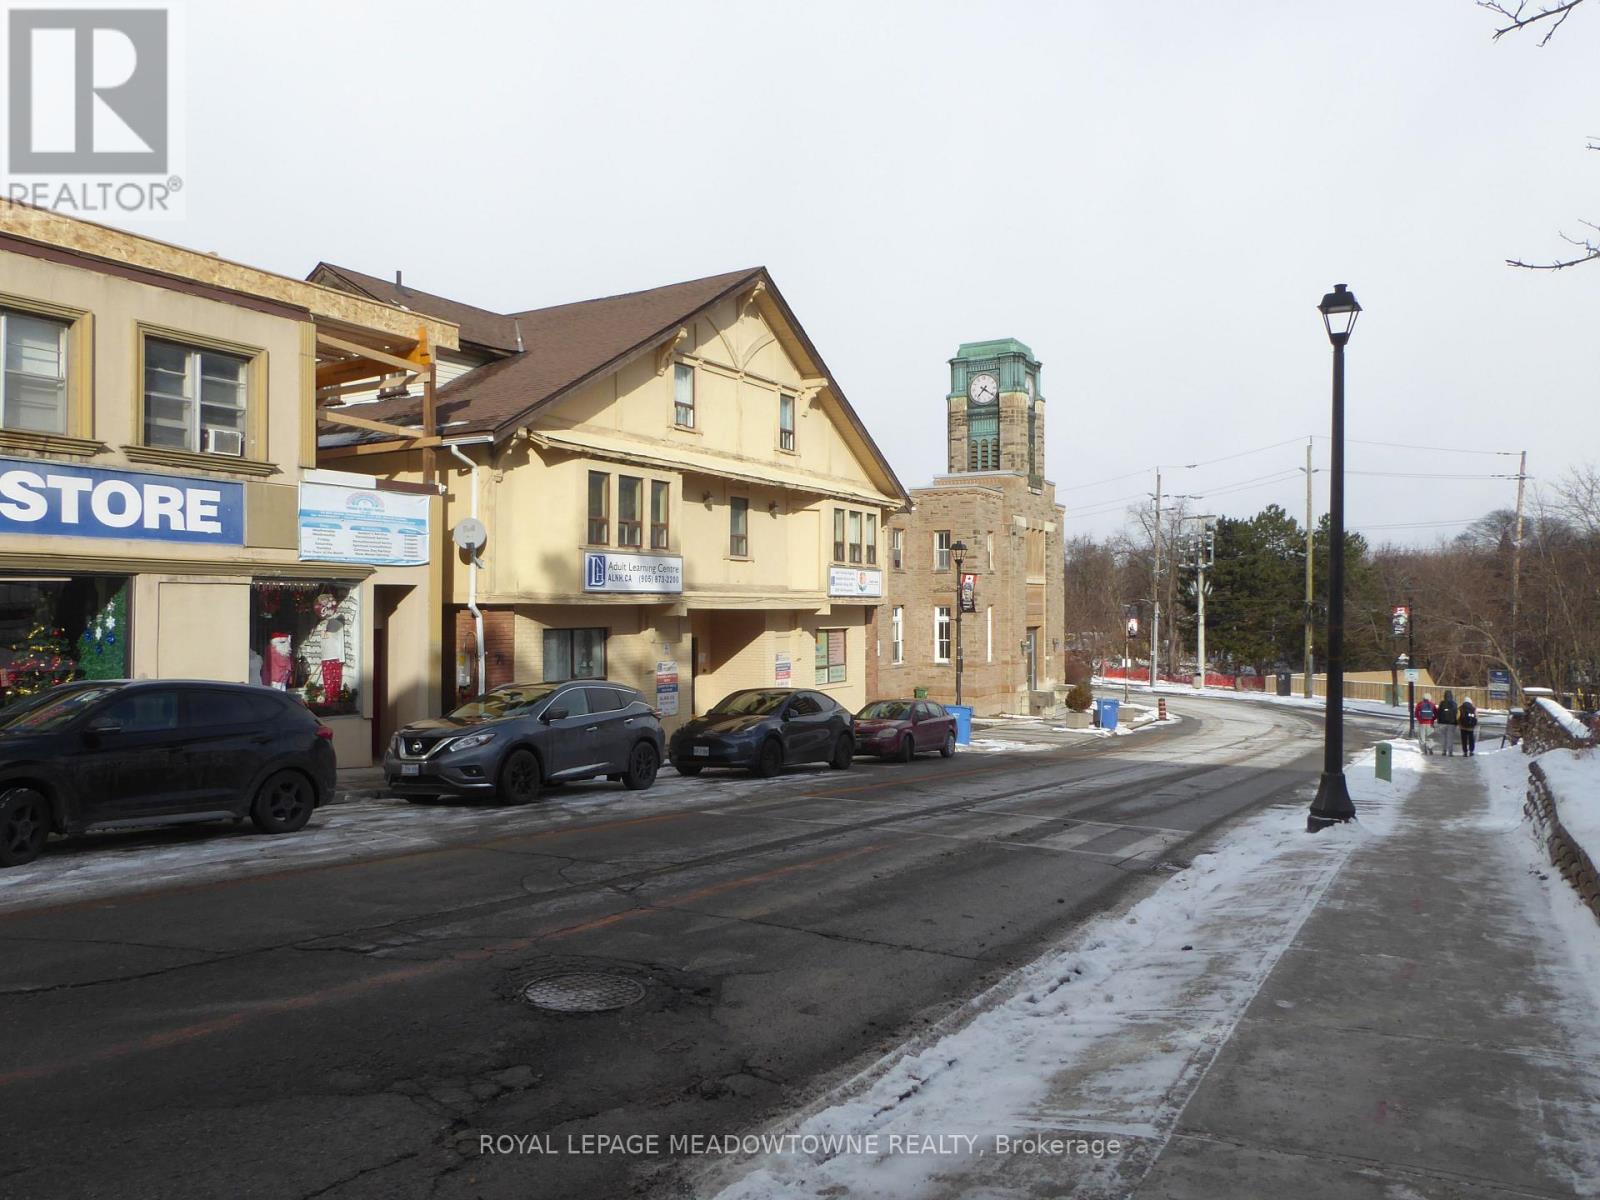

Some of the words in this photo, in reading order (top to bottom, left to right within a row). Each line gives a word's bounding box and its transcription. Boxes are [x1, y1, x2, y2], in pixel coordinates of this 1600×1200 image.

[0, 470, 222, 534] STORE
[608, 561, 627, 572] Adult
[628, 563, 656, 574] Learning
[657, 564, 680, 573] Centre
